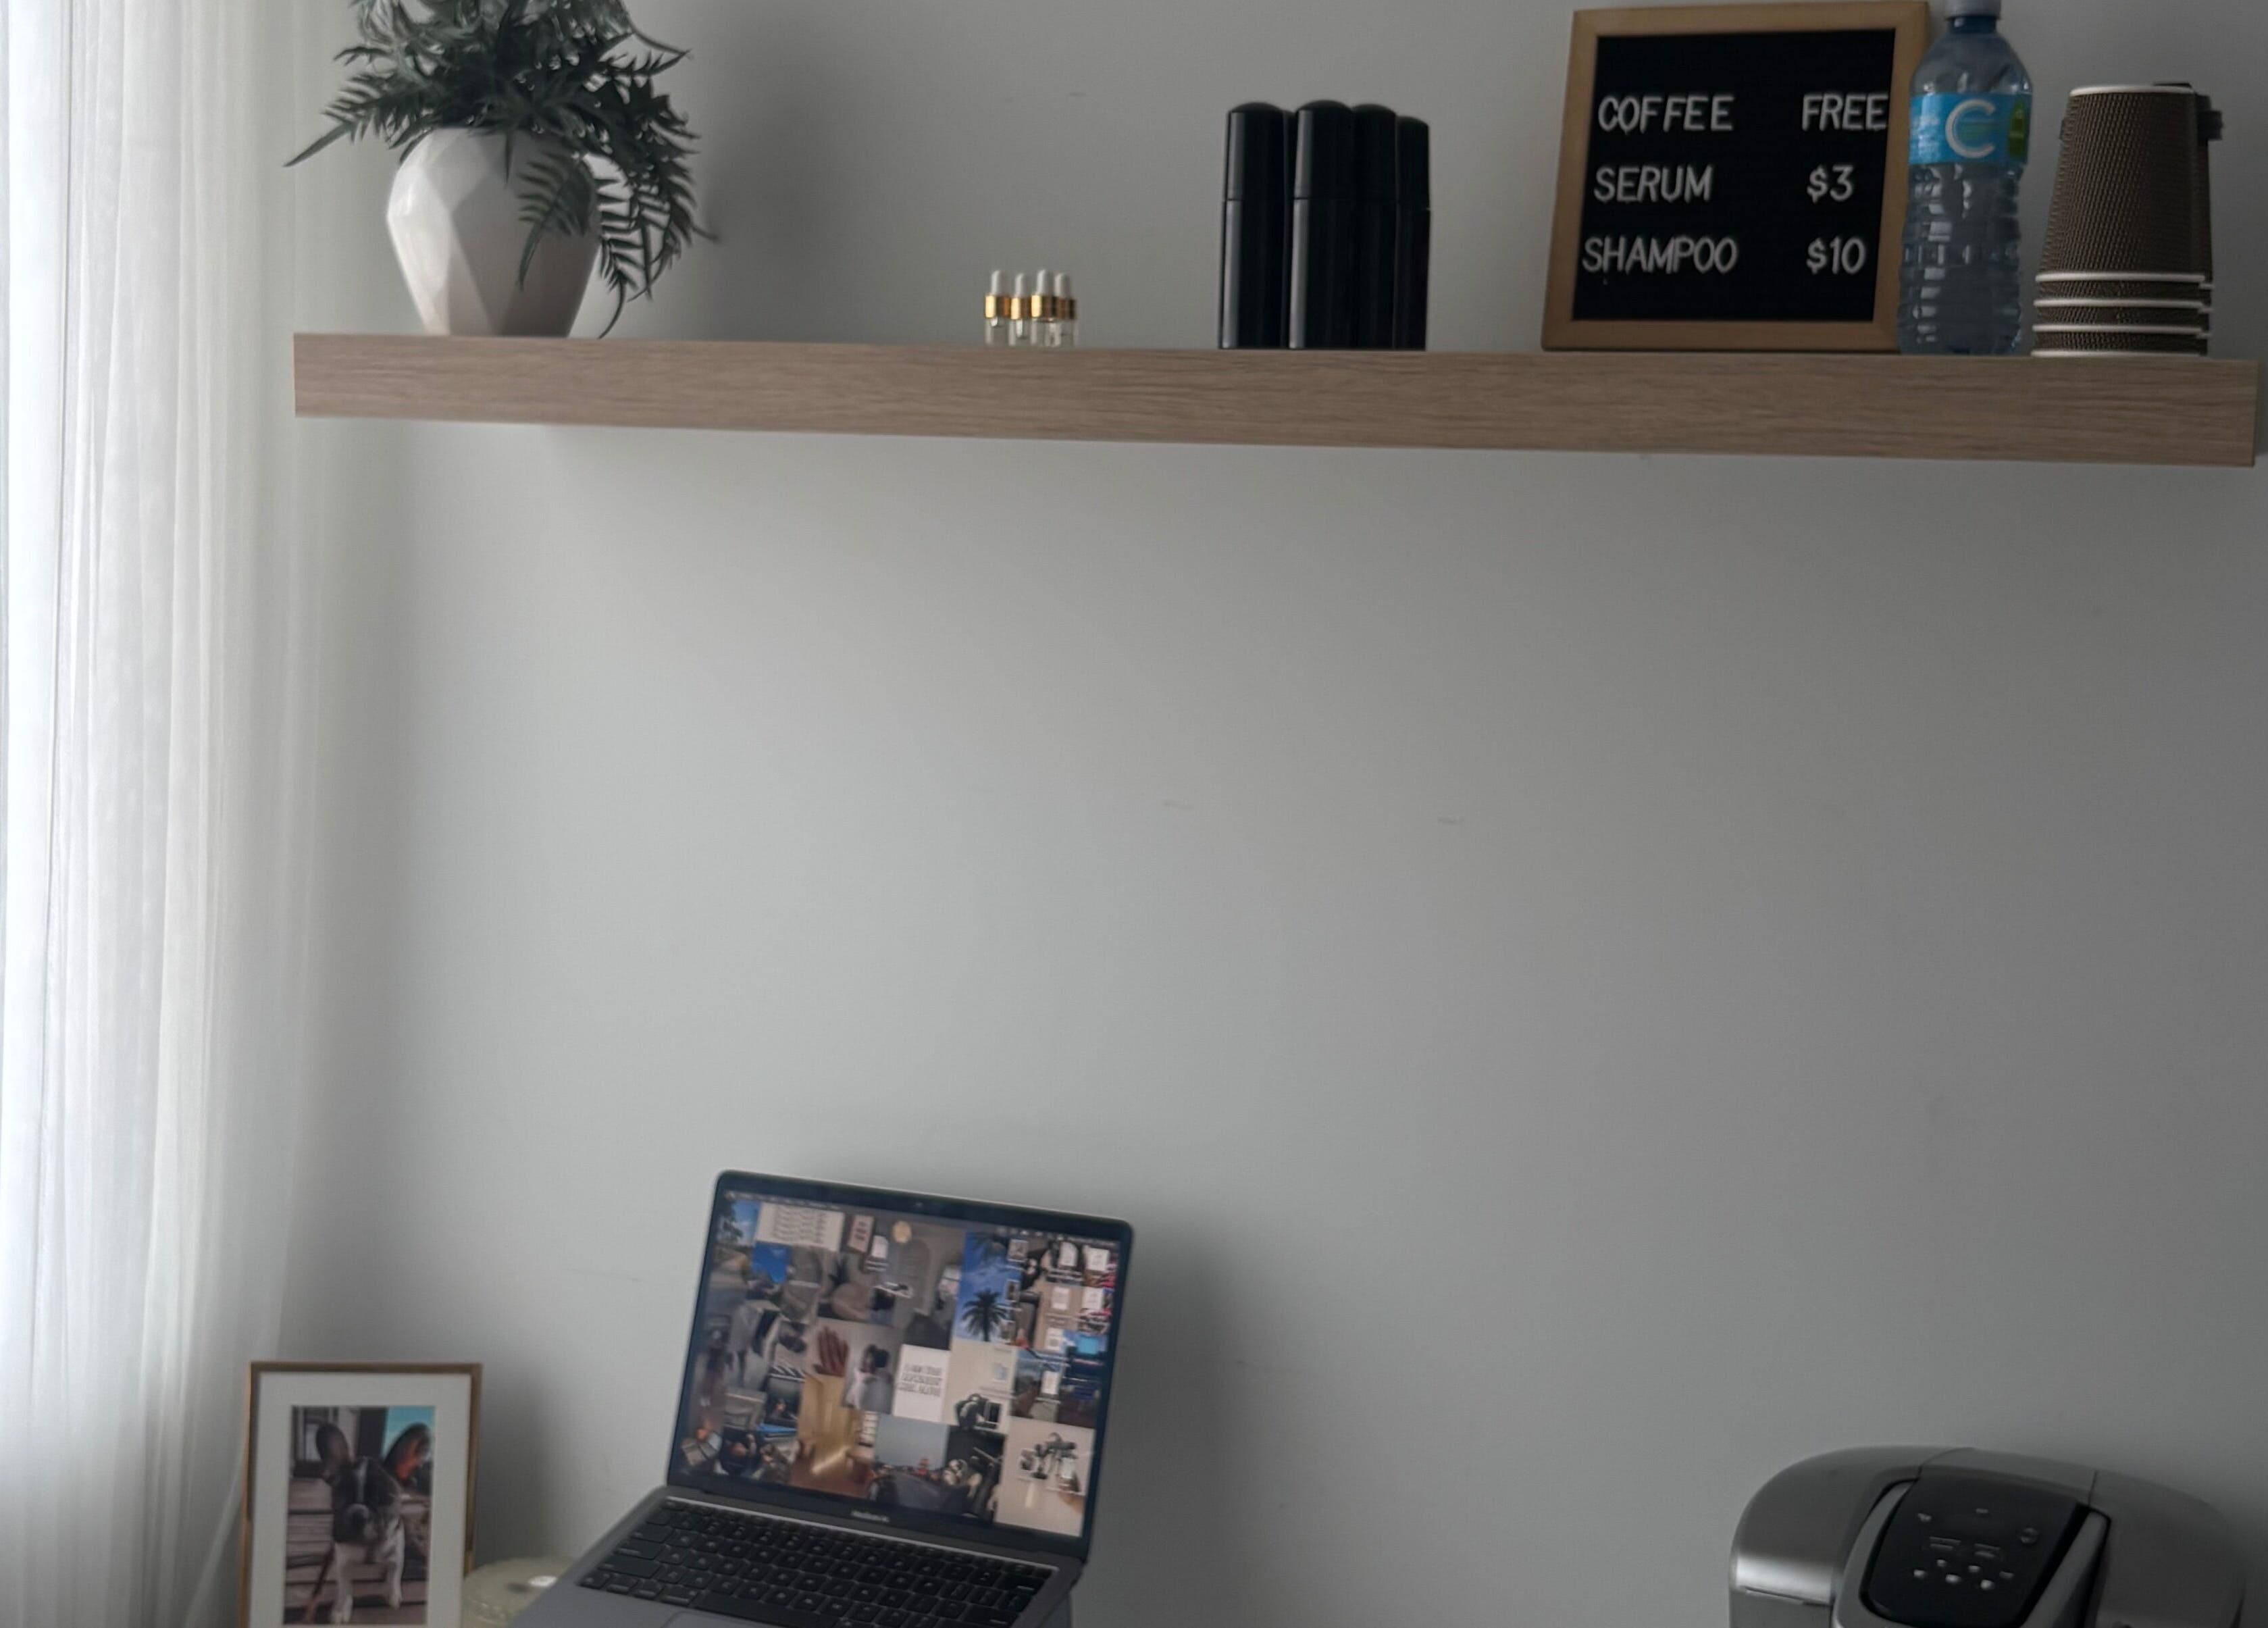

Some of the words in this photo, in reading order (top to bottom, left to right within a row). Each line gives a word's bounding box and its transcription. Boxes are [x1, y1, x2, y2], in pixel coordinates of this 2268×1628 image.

[1599, 96, 1734, 132] COFFEE
[1803, 93, 1888, 130] FREE
[1595, 166, 1711, 201] SERUM
[1808, 166, 1853, 202] $3
[1583, 237, 1736, 272] SHAMPOO
[1807, 238, 1865, 273] $10
